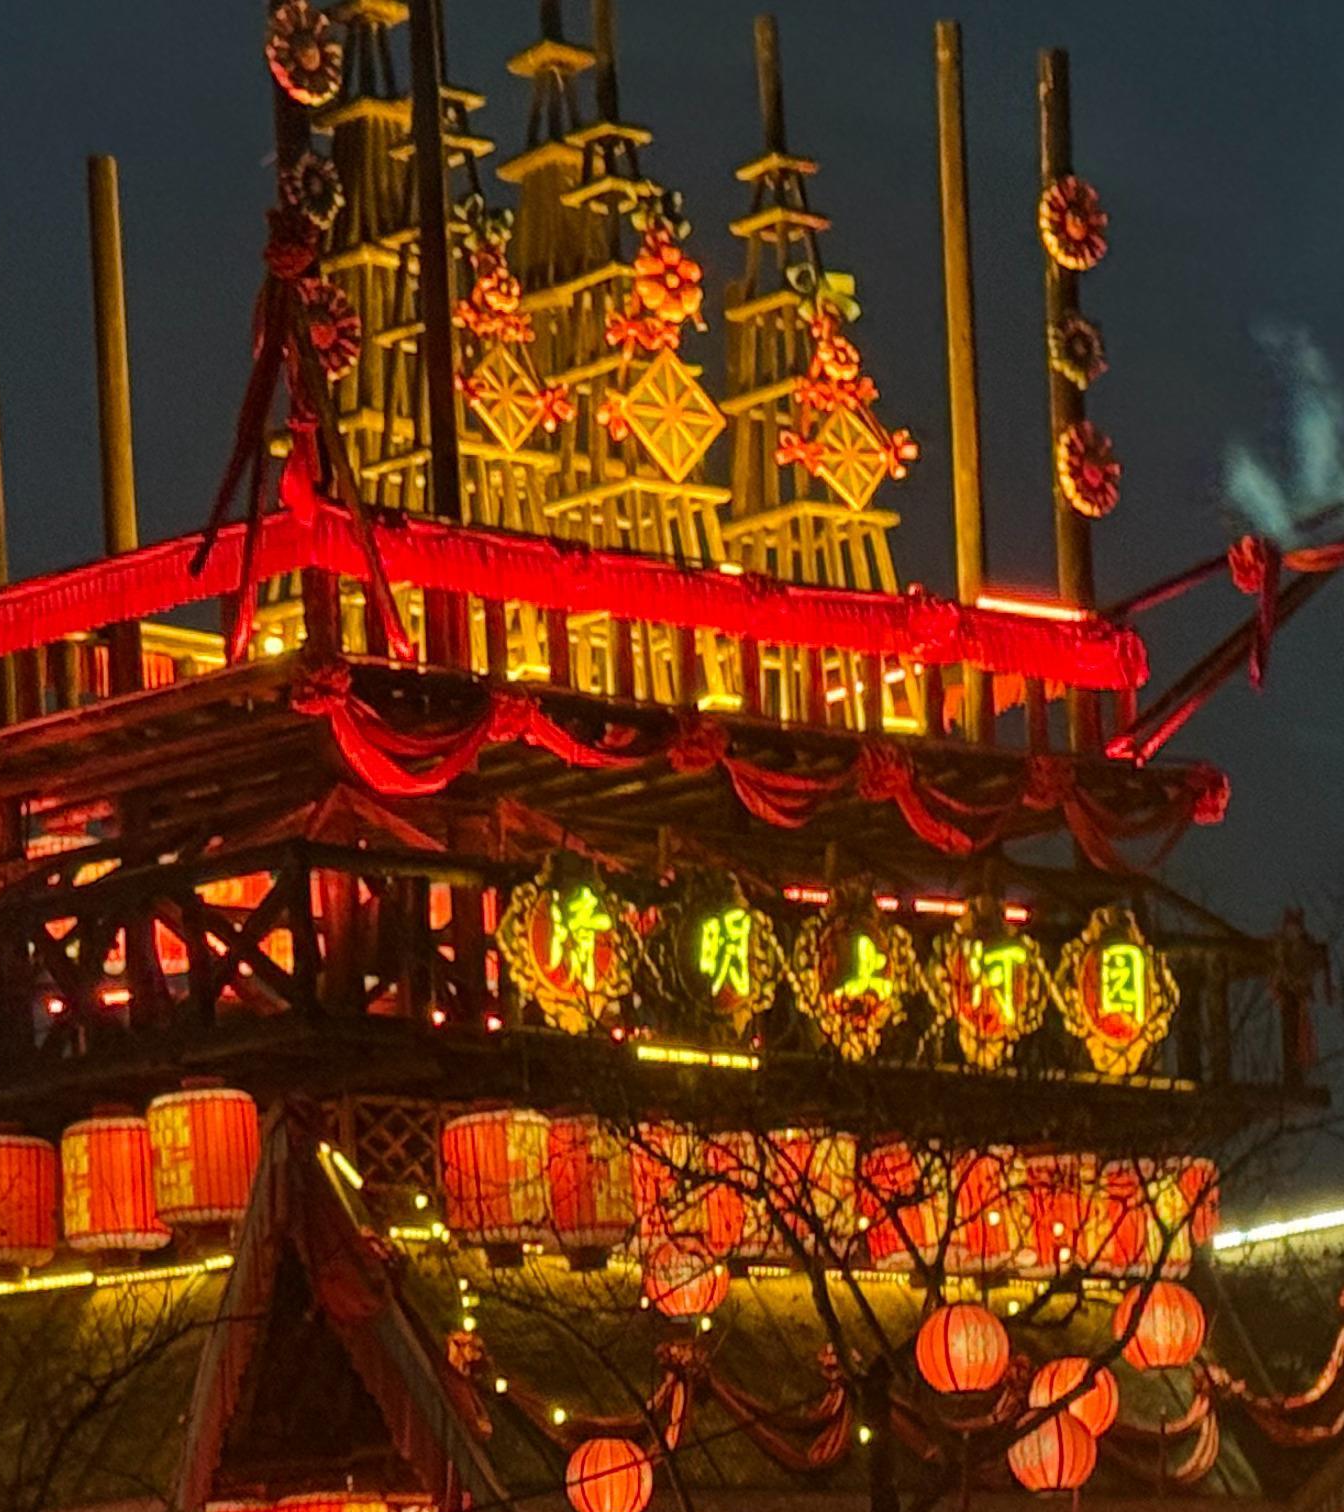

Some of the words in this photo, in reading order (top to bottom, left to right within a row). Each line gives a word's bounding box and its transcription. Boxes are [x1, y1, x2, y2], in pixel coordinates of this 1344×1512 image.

[544, 886, 1145, 1025] 清明上河园
